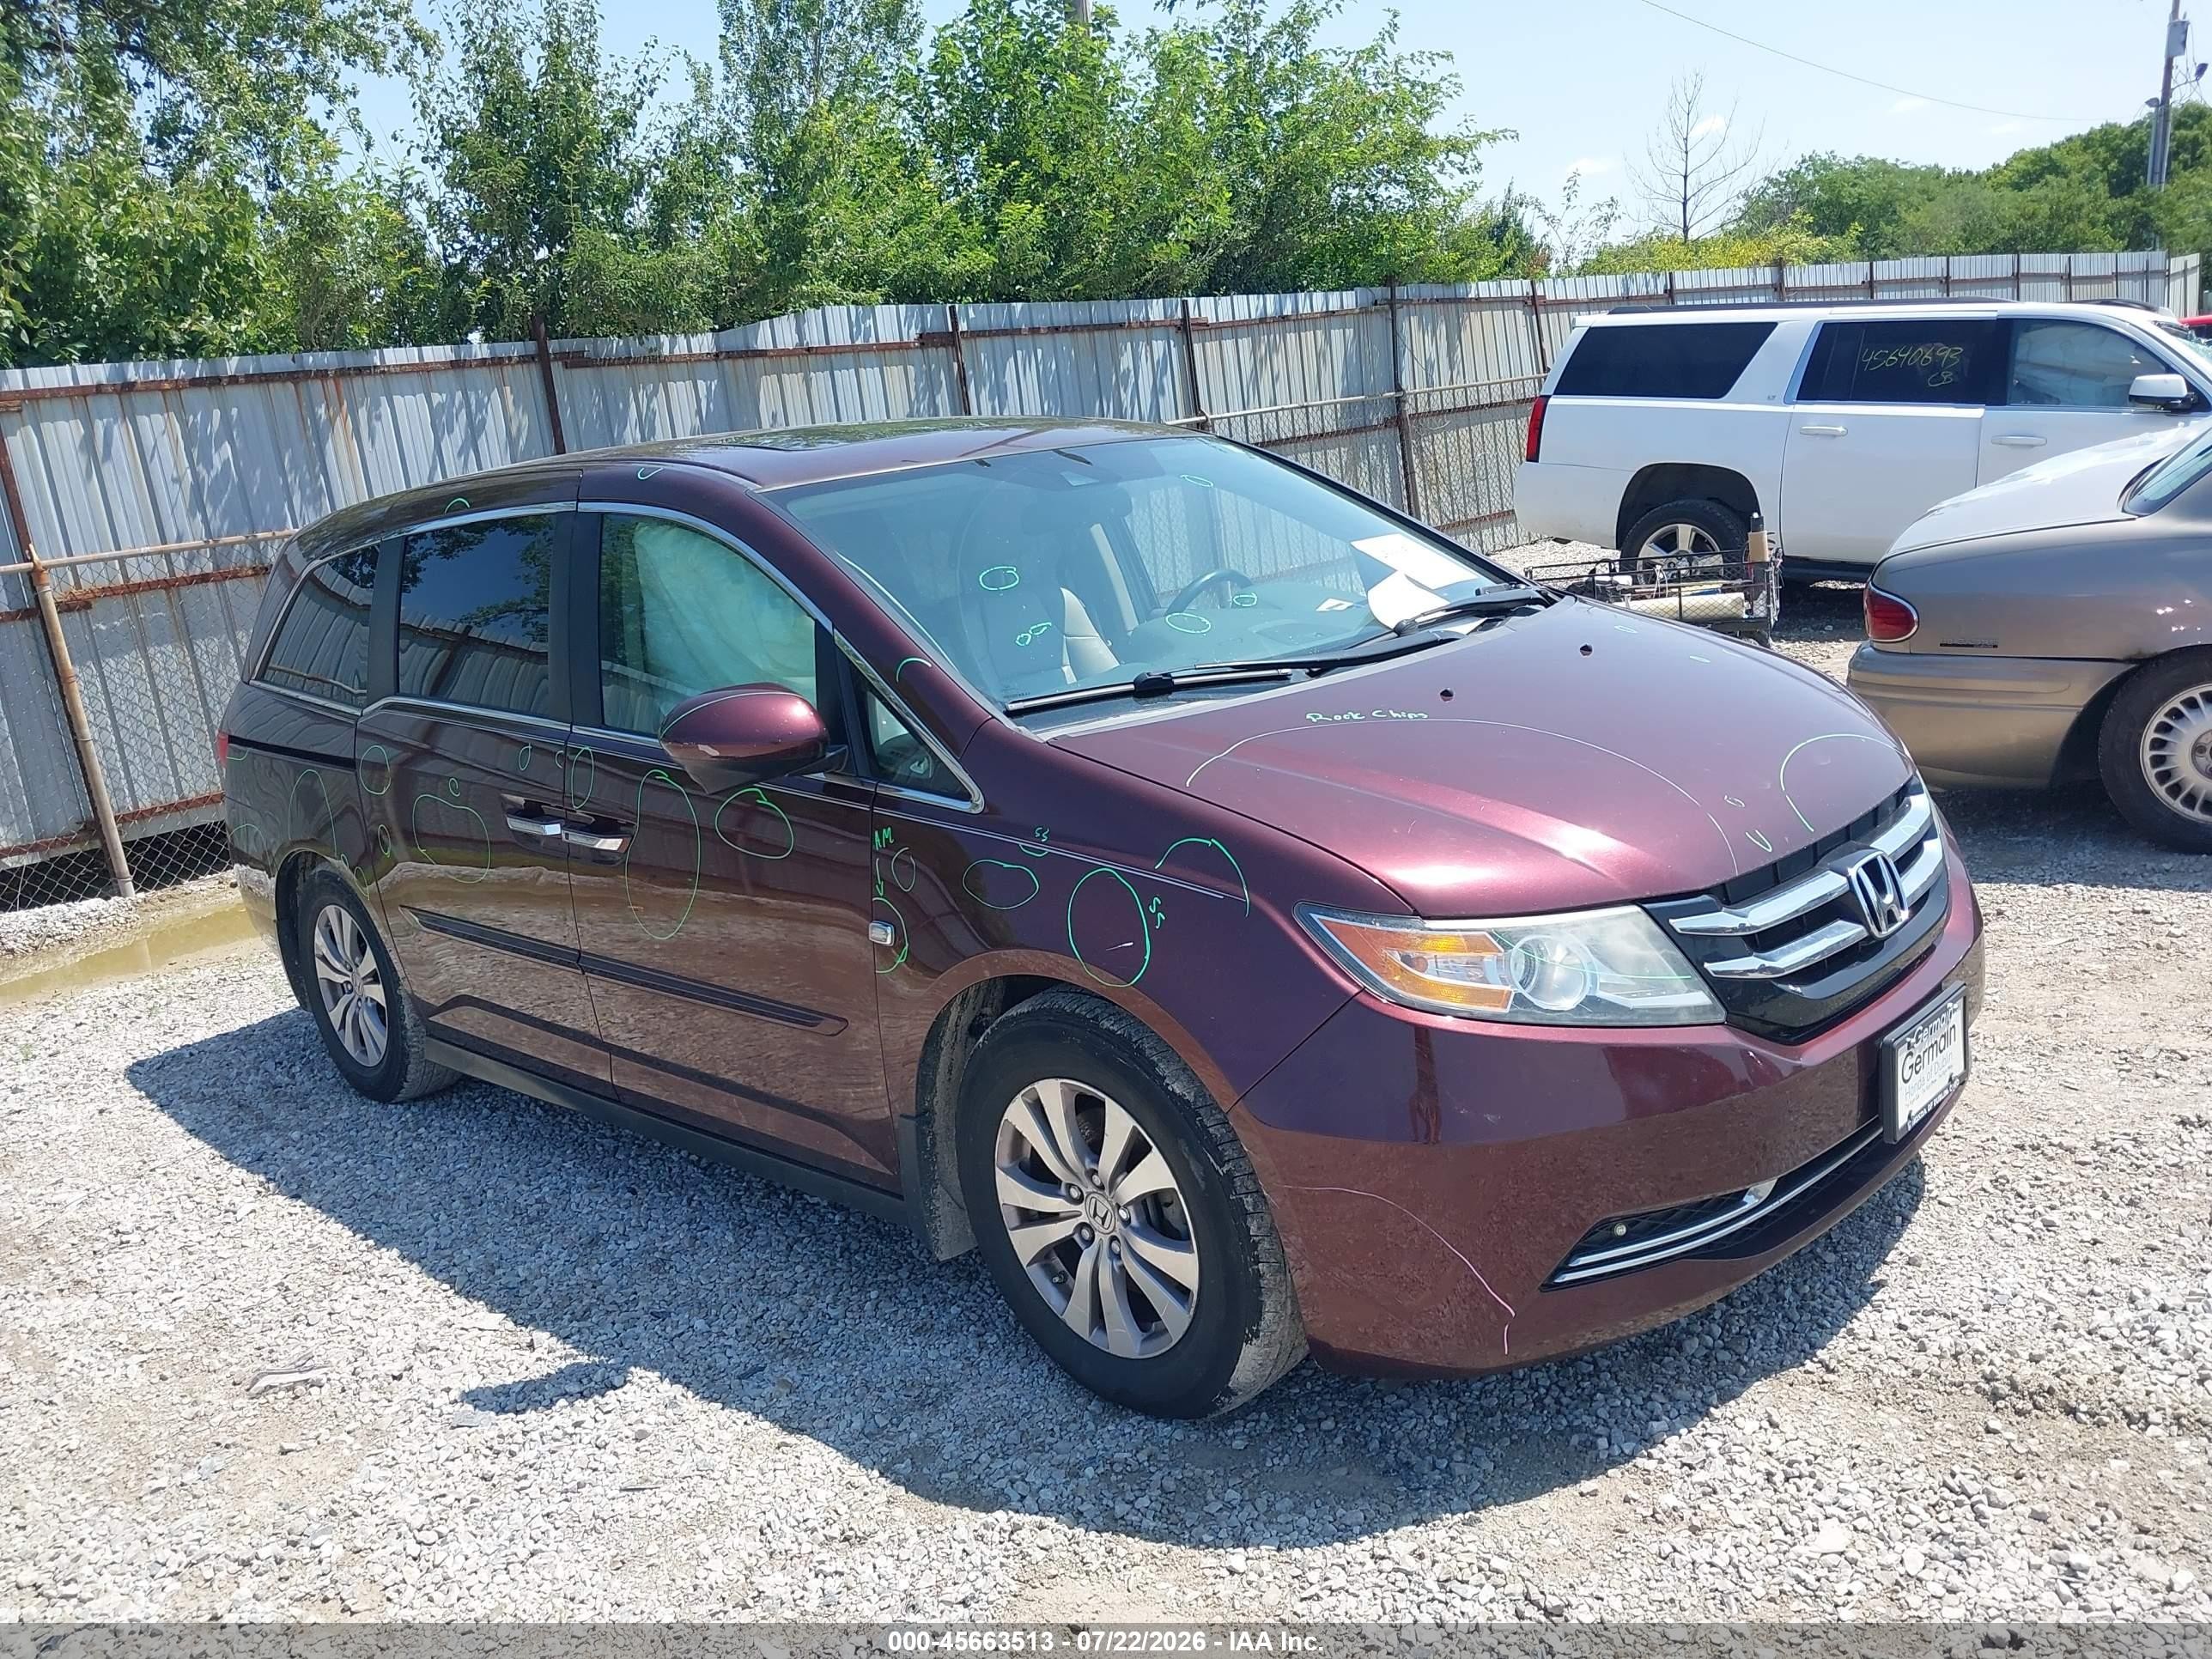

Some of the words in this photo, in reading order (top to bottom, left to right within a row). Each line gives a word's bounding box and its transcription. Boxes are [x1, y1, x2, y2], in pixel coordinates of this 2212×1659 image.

[1862, 345, 1964, 371] 45640693
[1372, 709, 1429, 720] Chips
[1914, 1007, 1954, 1048] Germain
[1901, 1024, 1957, 1084] Germain
